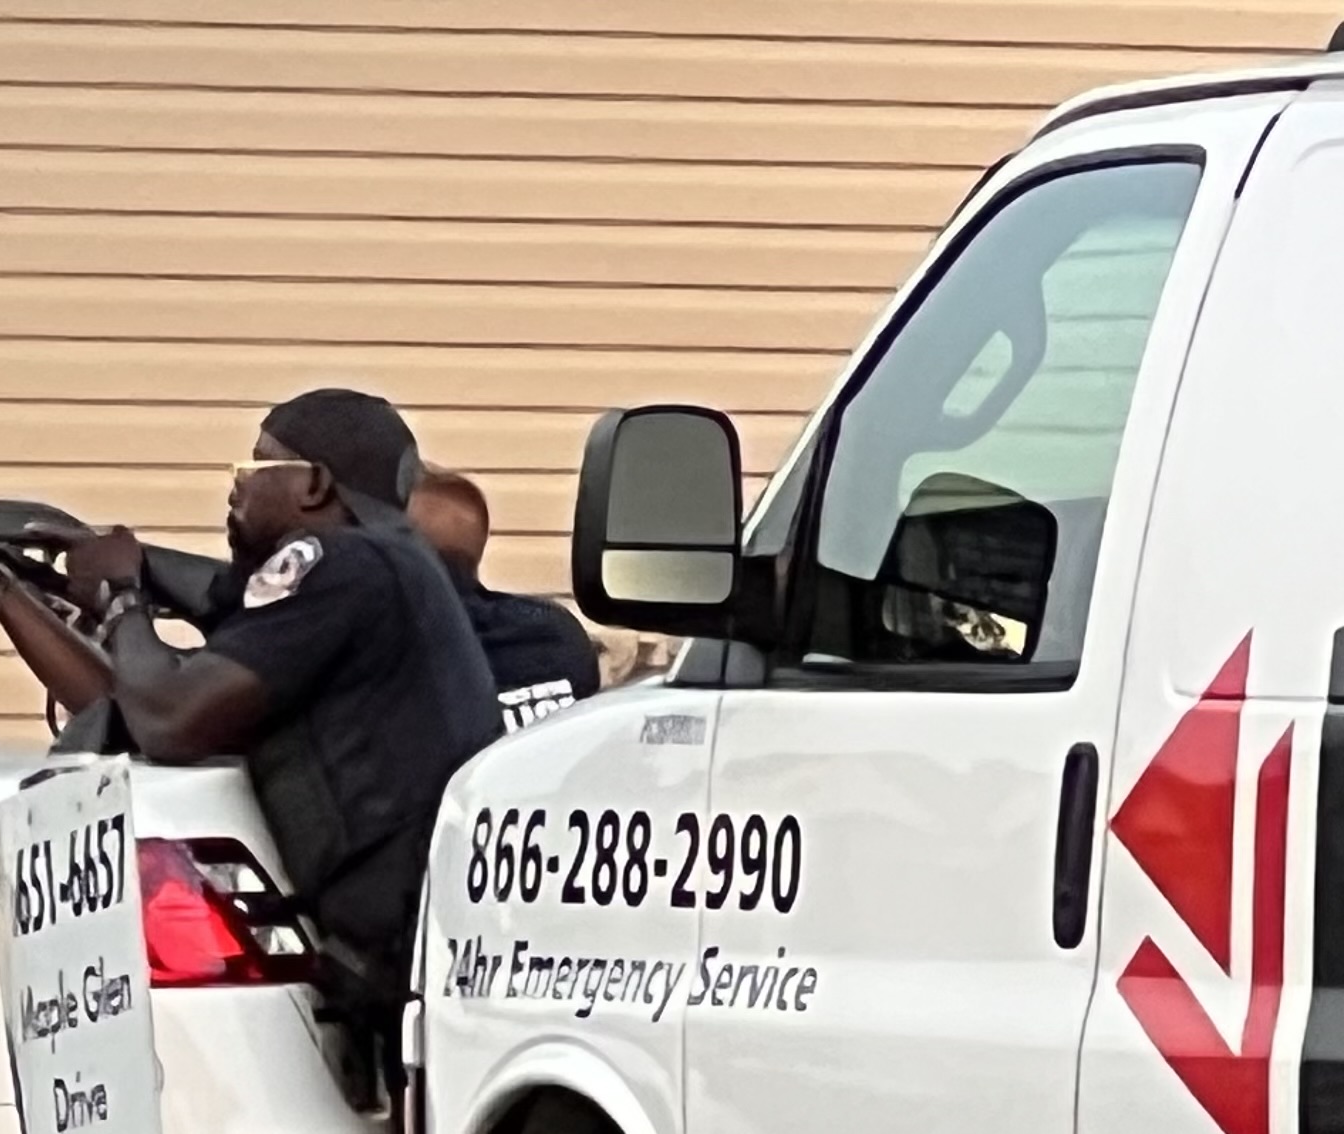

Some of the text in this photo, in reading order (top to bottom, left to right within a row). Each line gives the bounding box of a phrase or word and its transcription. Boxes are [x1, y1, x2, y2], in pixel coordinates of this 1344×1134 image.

[13, 813, 125, 937] 651-6657
[466, 806, 802, 914] 866-288-2990
[20, 968, 78, 1055] Maple
[443, 934, 818, 1023] 24hr Emergency Service
[52, 1070, 108, 1133] Drive
